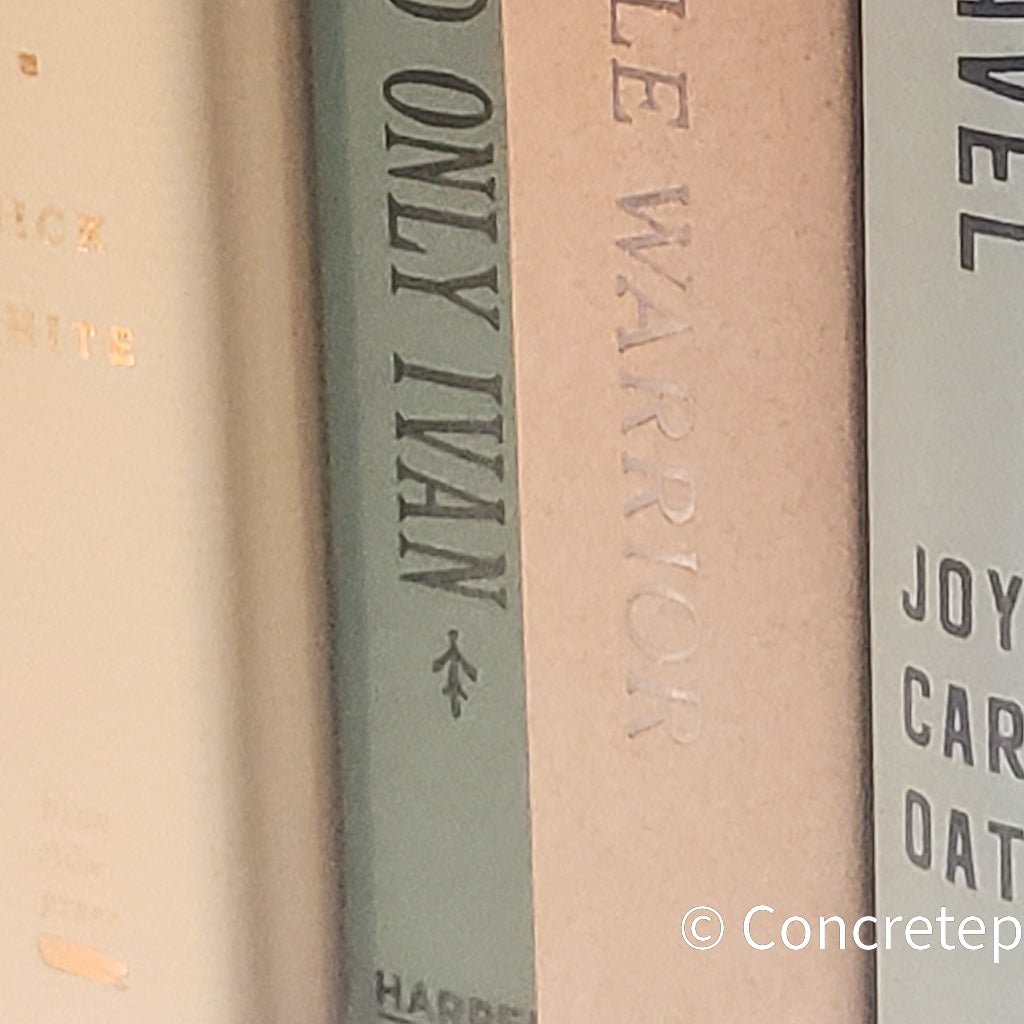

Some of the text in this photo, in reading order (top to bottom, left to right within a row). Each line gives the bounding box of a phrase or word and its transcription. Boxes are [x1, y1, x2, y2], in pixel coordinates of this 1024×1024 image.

[382, 68, 502, 331] ONLY
[393, 352, 508, 610] IVAN
[615, 184, 700, 745] WARRIOR
